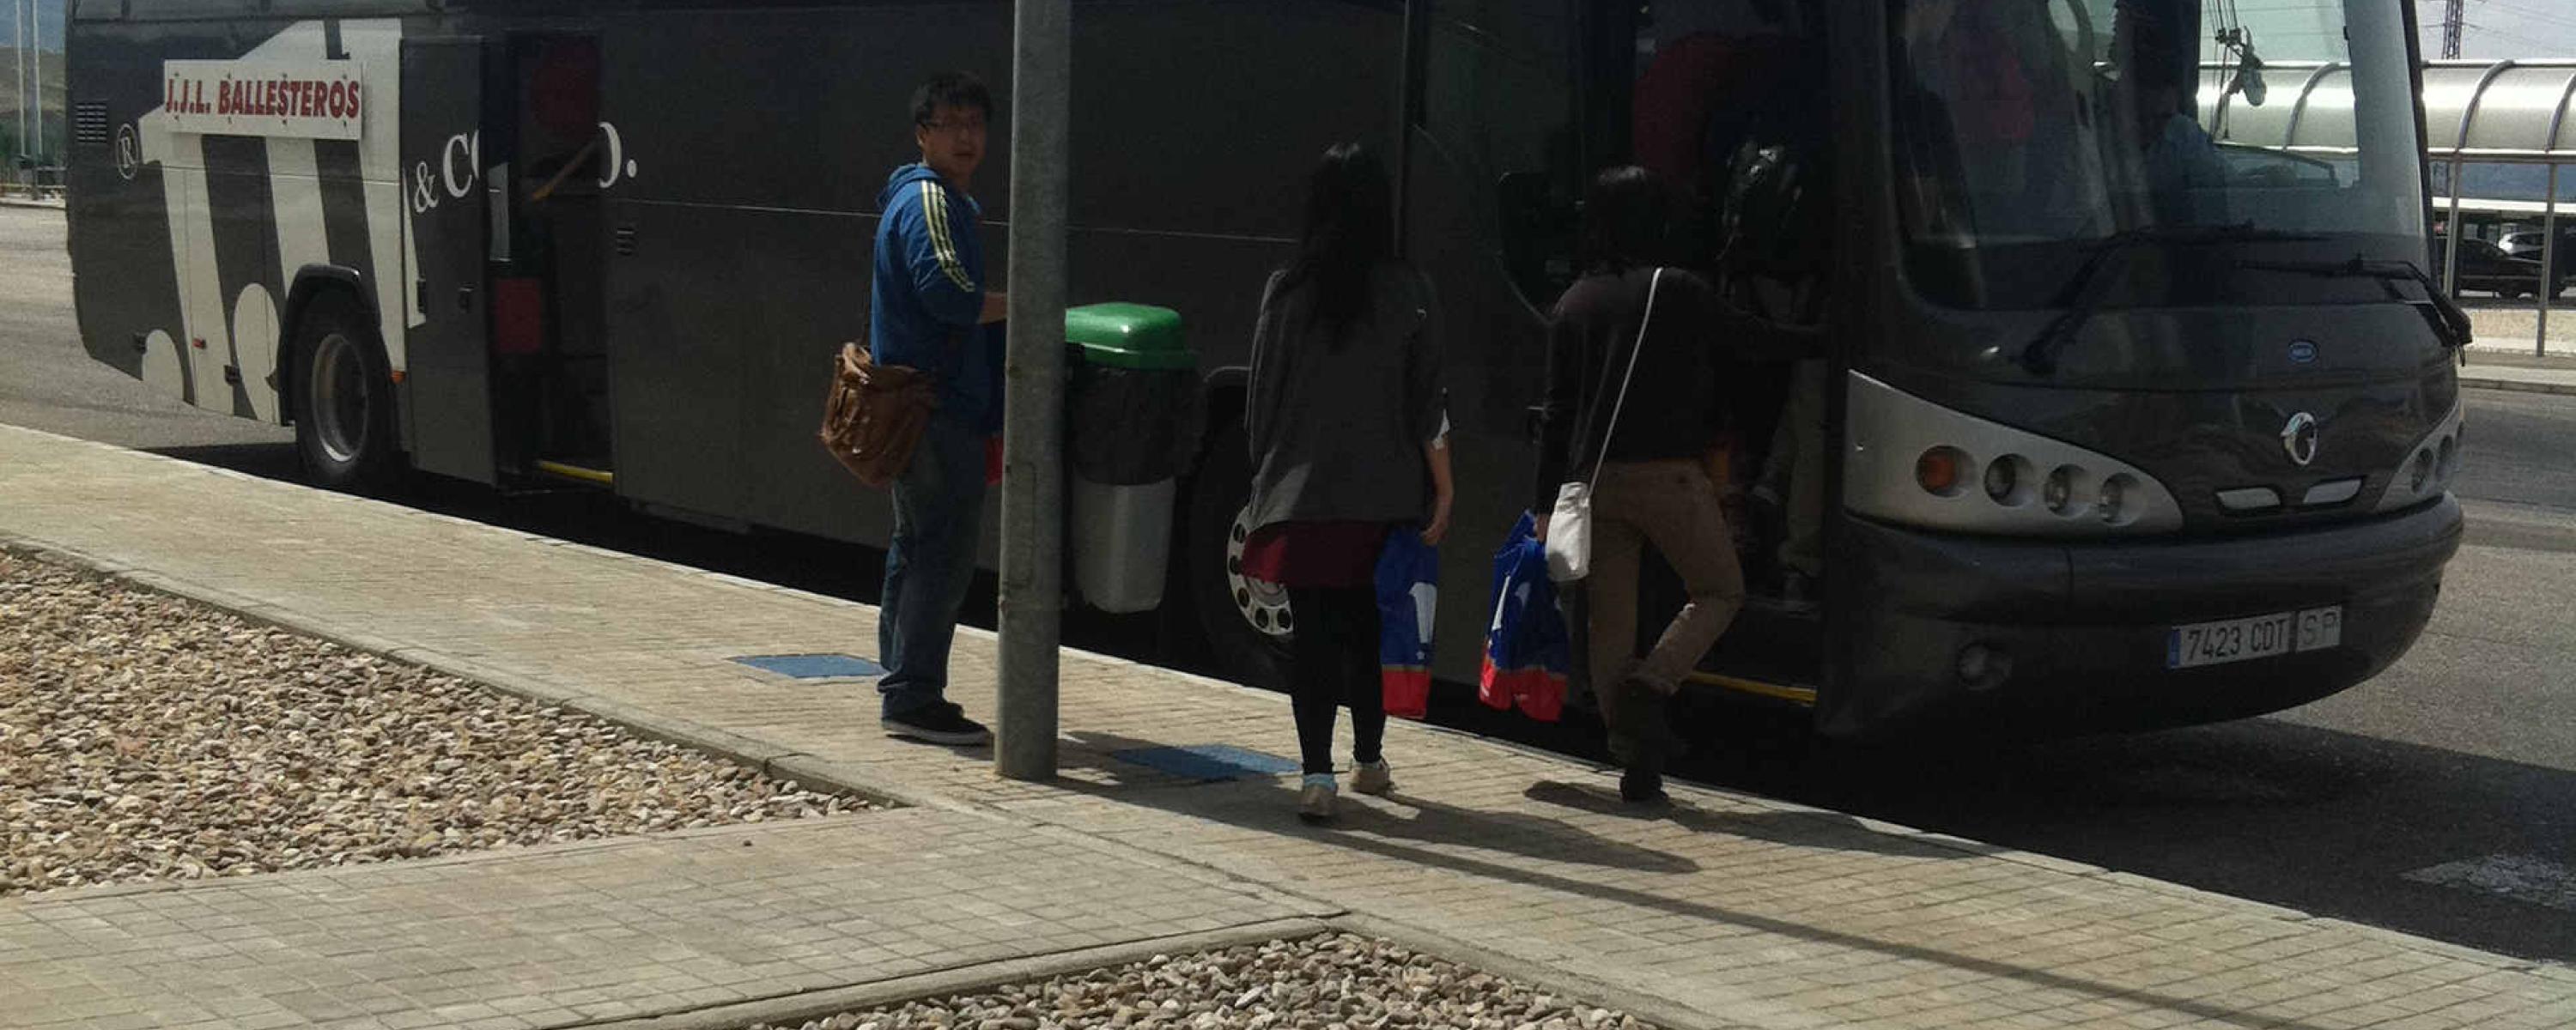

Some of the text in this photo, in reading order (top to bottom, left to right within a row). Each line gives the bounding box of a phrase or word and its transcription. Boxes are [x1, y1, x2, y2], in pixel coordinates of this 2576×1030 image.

[166, 79, 360, 118] J.J.L. BALLESTEROS
[414, 161, 439, 213] &
[2188, 627, 2241, 660] 7423
[2250, 619, 2287, 652] CDT
